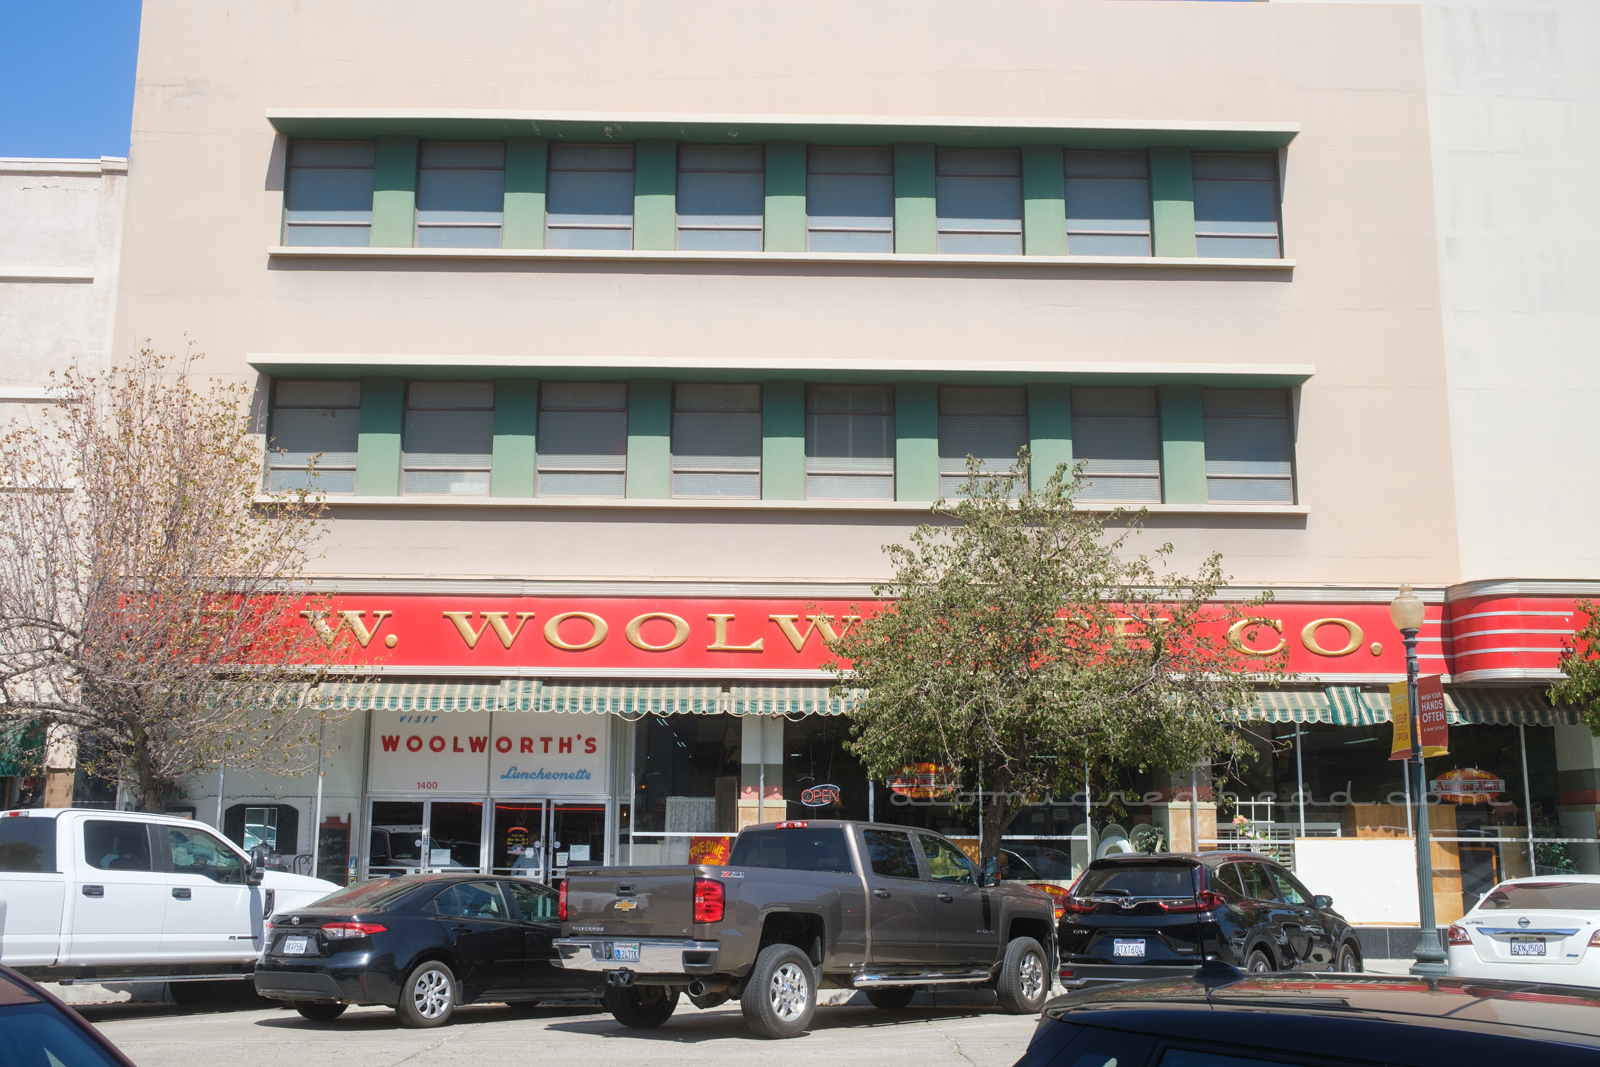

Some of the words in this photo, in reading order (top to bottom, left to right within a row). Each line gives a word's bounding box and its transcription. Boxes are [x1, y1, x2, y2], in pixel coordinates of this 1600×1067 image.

[299, 610, 398, 648] W.
[442, 611, 1170, 653] WOOLWH
[1226, 617, 1384, 657] CO.
[1421, 700, 1443, 711] HANDS
[399, 715, 438, 723] VISIT
[1422, 711, 1444, 723] OFTEN
[1396, 732, 1408, 741] OPEN
[381, 734, 597, 754] WOOLWORTH'S
[500, 766, 592, 780] Luncheonette
[416, 781, 438, 790] 1400
[801, 789, 839, 802] OPEN
[690, 841, 705, 859] FIVE
[706, 839, 725, 859] DIME
[350, 858, 356, 869] A
[1045, 886, 1064, 896] Dime
[1115, 945, 1144, 954] 8TXT604
